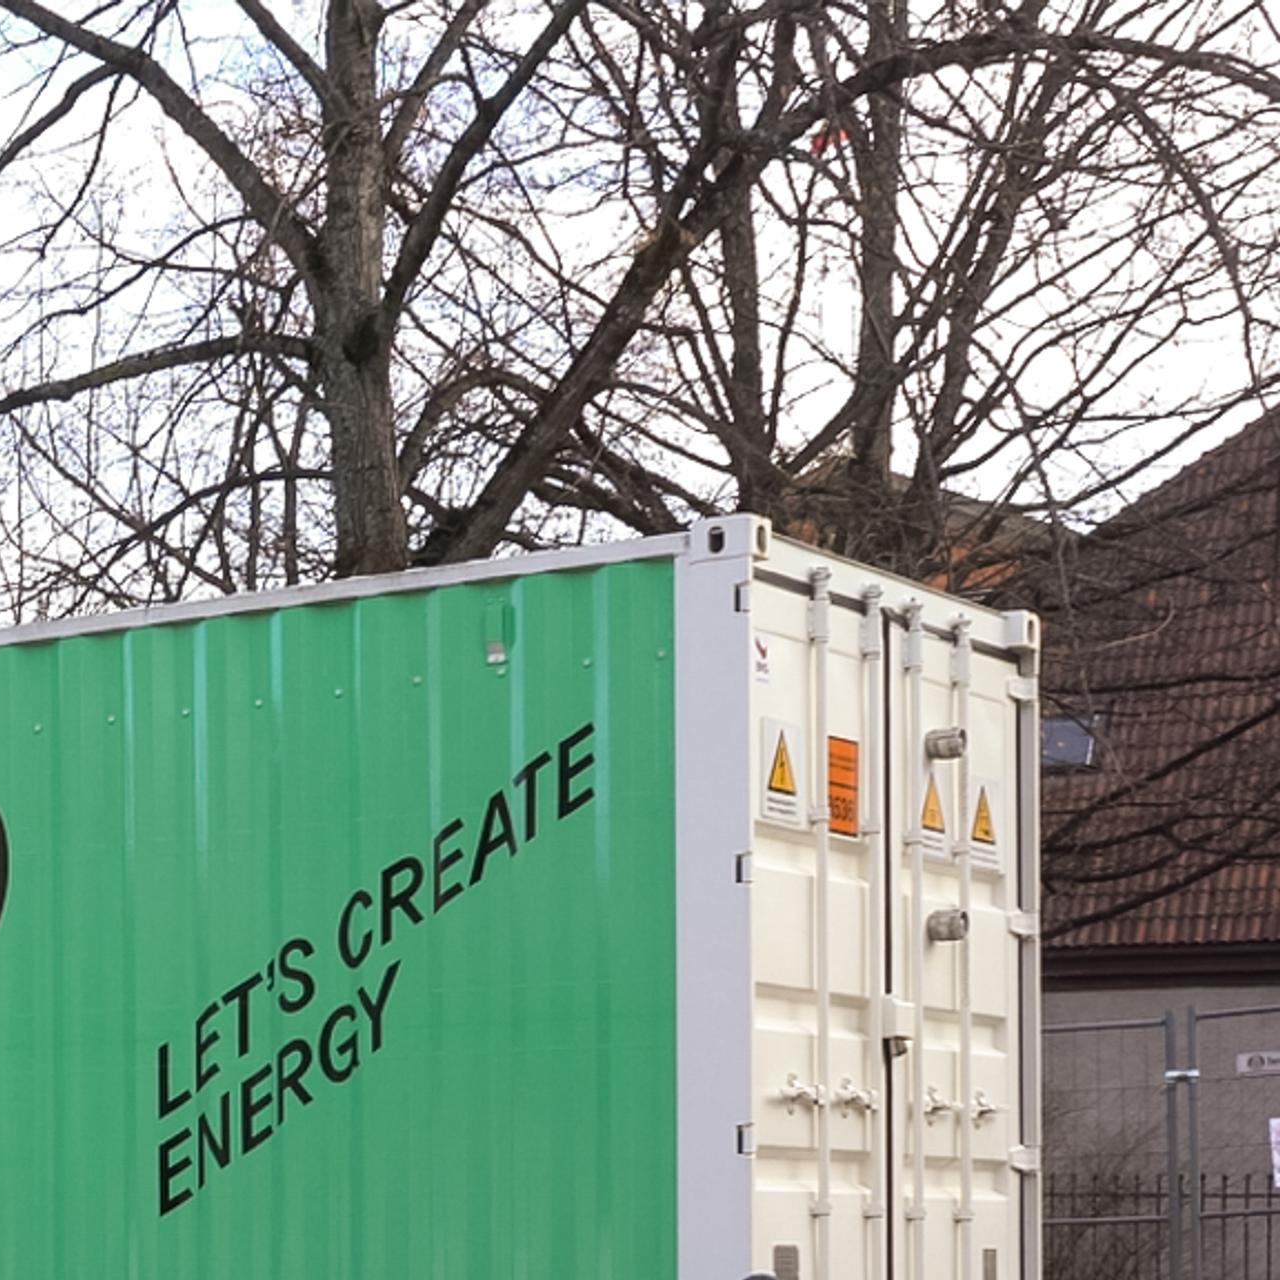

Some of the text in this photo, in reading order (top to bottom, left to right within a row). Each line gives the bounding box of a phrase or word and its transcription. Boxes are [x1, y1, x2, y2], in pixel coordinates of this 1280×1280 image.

[158, 722, 595, 1120] LET'S CREATE
[158, 959, 401, 1217] ENERGY
